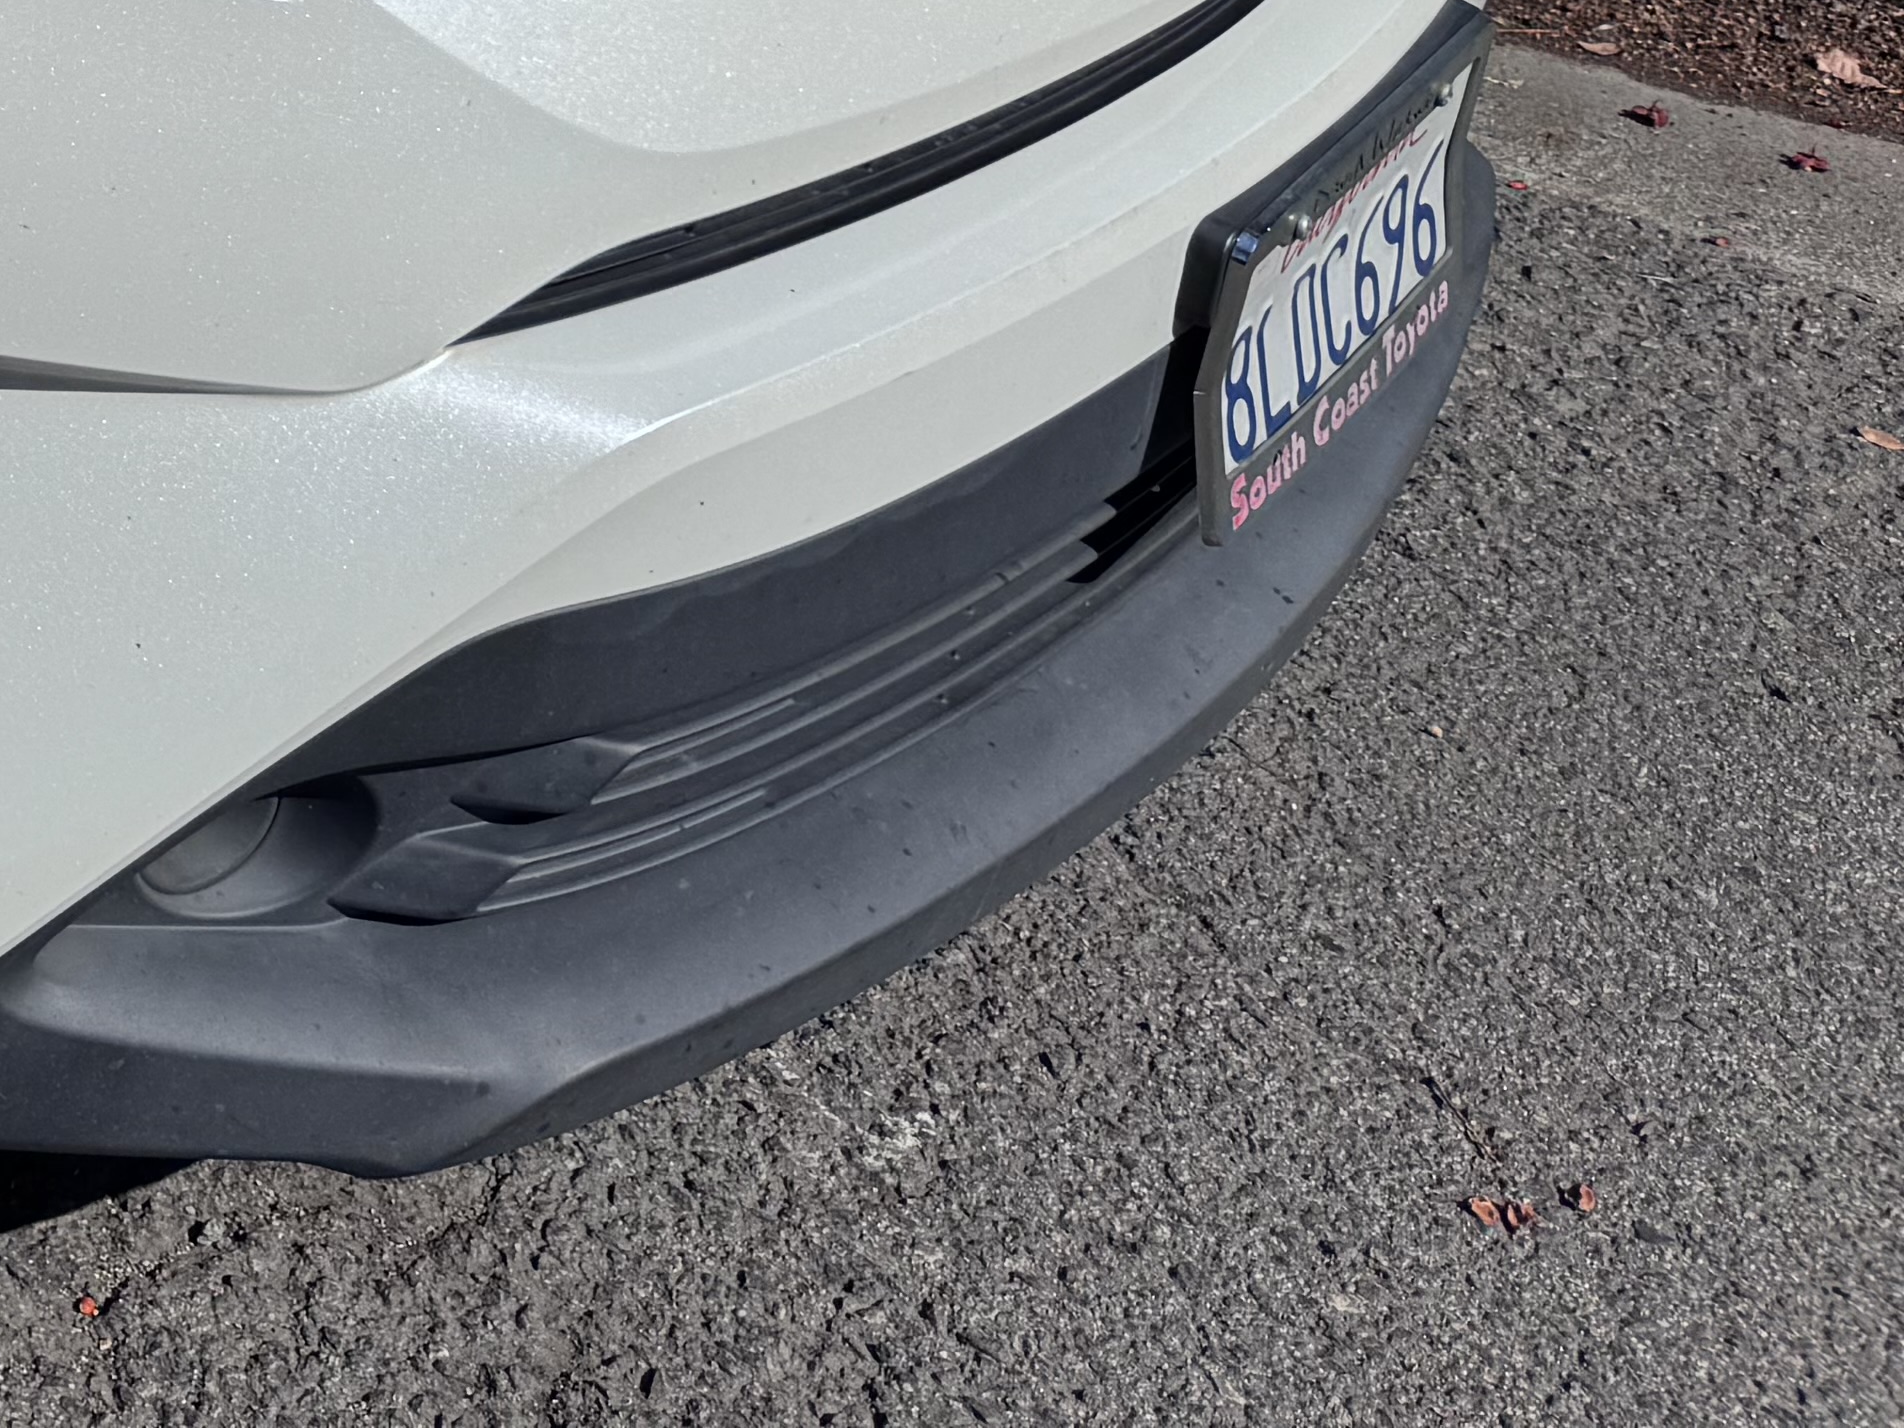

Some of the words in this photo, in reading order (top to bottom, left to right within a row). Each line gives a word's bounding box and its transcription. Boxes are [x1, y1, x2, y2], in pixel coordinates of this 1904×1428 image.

[1230, 431, 1307, 531] South
[1313, 357, 1379, 446] Coast
[1381, 280, 1449, 377] Toyota
